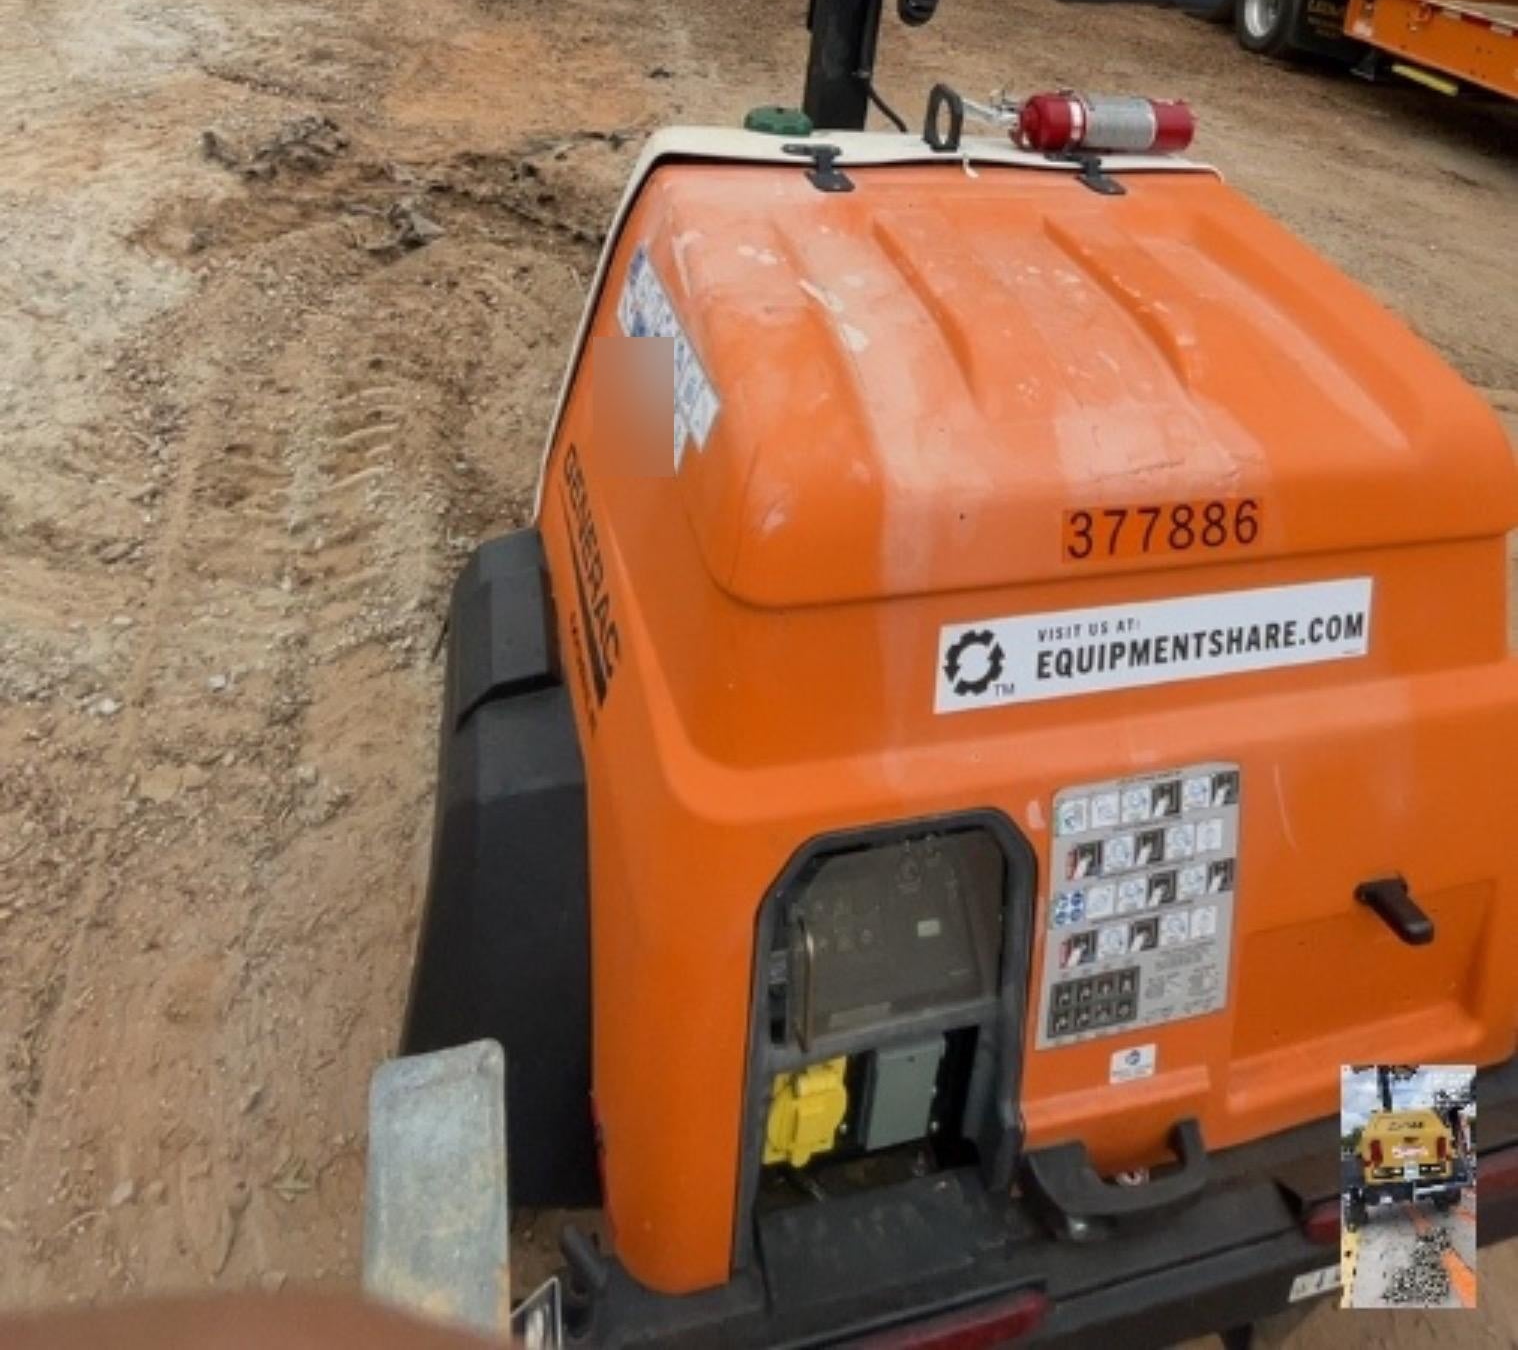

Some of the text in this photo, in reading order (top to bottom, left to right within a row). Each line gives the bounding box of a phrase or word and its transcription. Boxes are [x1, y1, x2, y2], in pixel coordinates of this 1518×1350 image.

[1067, 499, 1258, 559] 377886
[1036, 611, 1364, 681] EQUIPMENTSHARE.COM
[1037, 617, 1141, 643] VISIT US AT:
